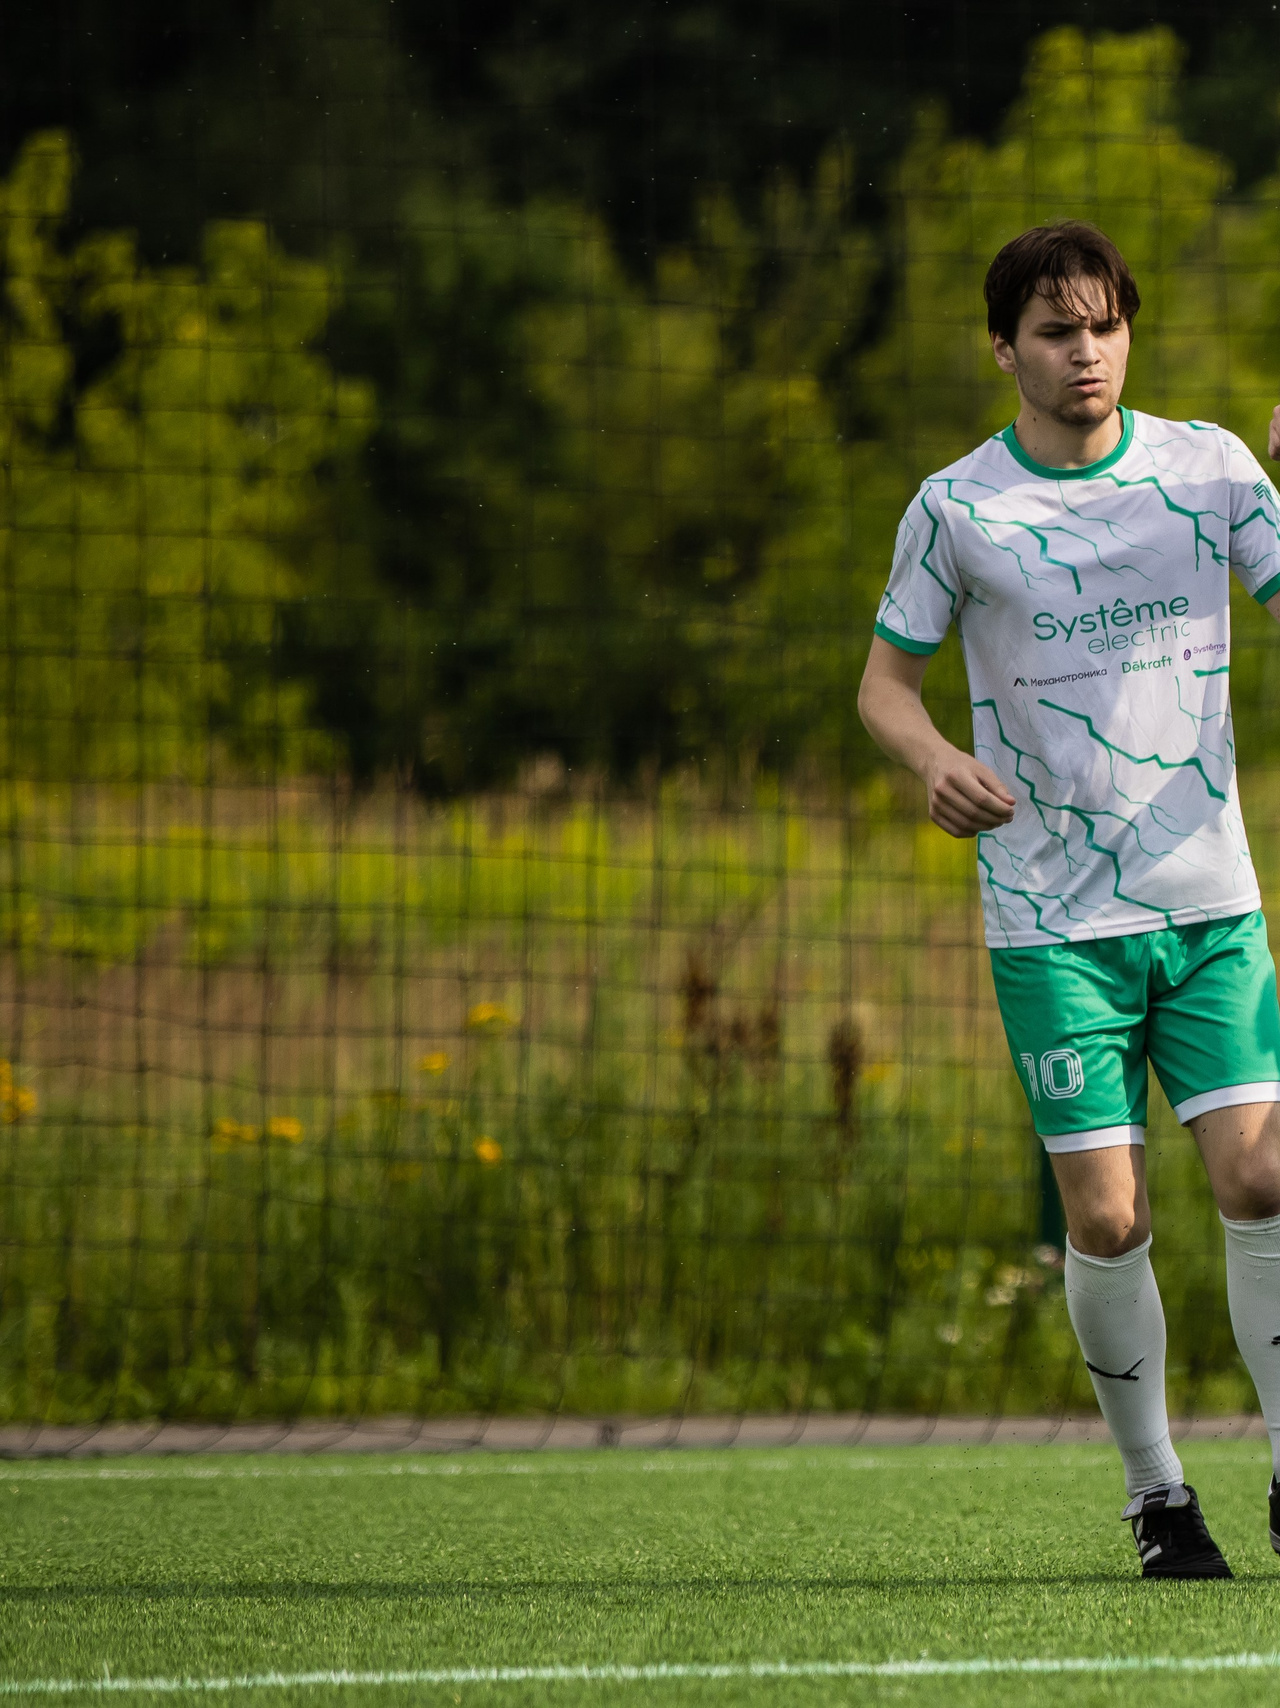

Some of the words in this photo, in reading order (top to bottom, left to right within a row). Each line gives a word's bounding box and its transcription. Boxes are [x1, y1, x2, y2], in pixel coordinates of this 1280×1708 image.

[1033, 596, 1190, 643] Systême
[1087, 621, 1191, 655] electric
[1030, 667, 1108, 687] Механотроника
[1121, 655, 1173, 674] Dēkraft
[1020, 1048, 1084, 1101] 10
